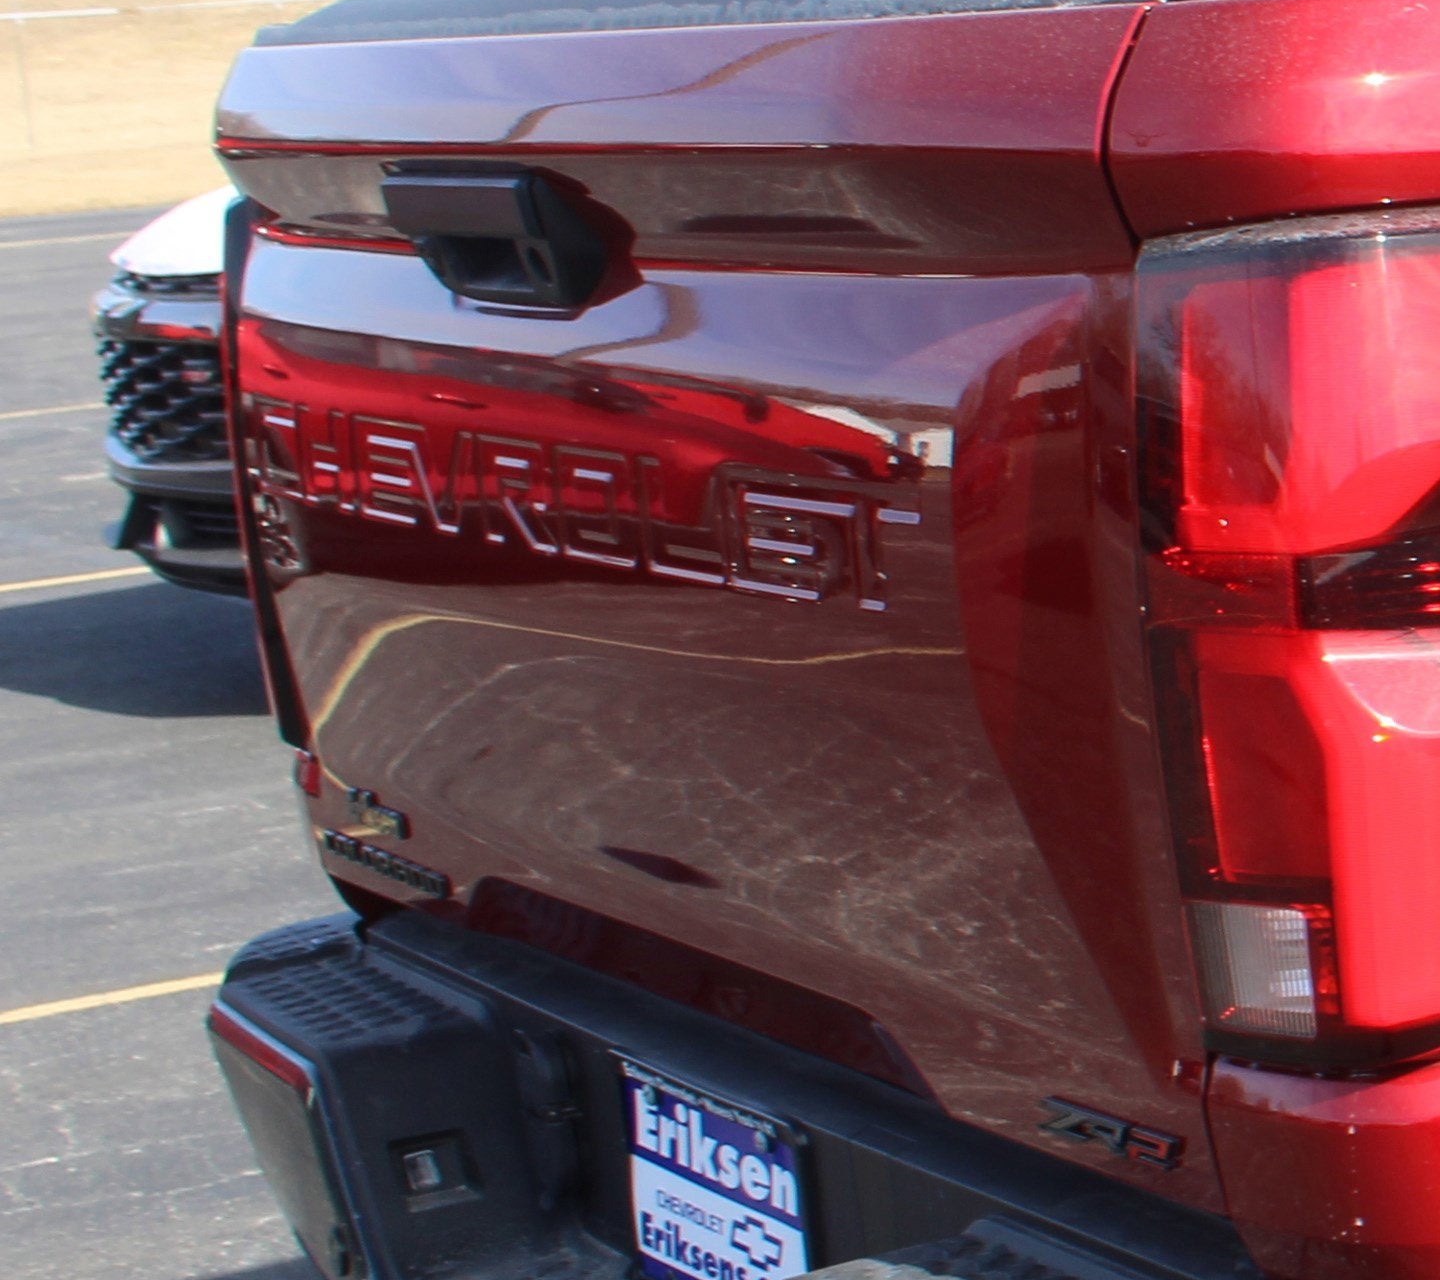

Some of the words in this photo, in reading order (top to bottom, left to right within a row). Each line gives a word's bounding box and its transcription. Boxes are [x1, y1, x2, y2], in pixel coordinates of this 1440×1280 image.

[243, 392, 922, 612] CHEVROLET
[633, 1087, 799, 1217] Eriksen
[656, 1189, 725, 1235] CHEVROLET
